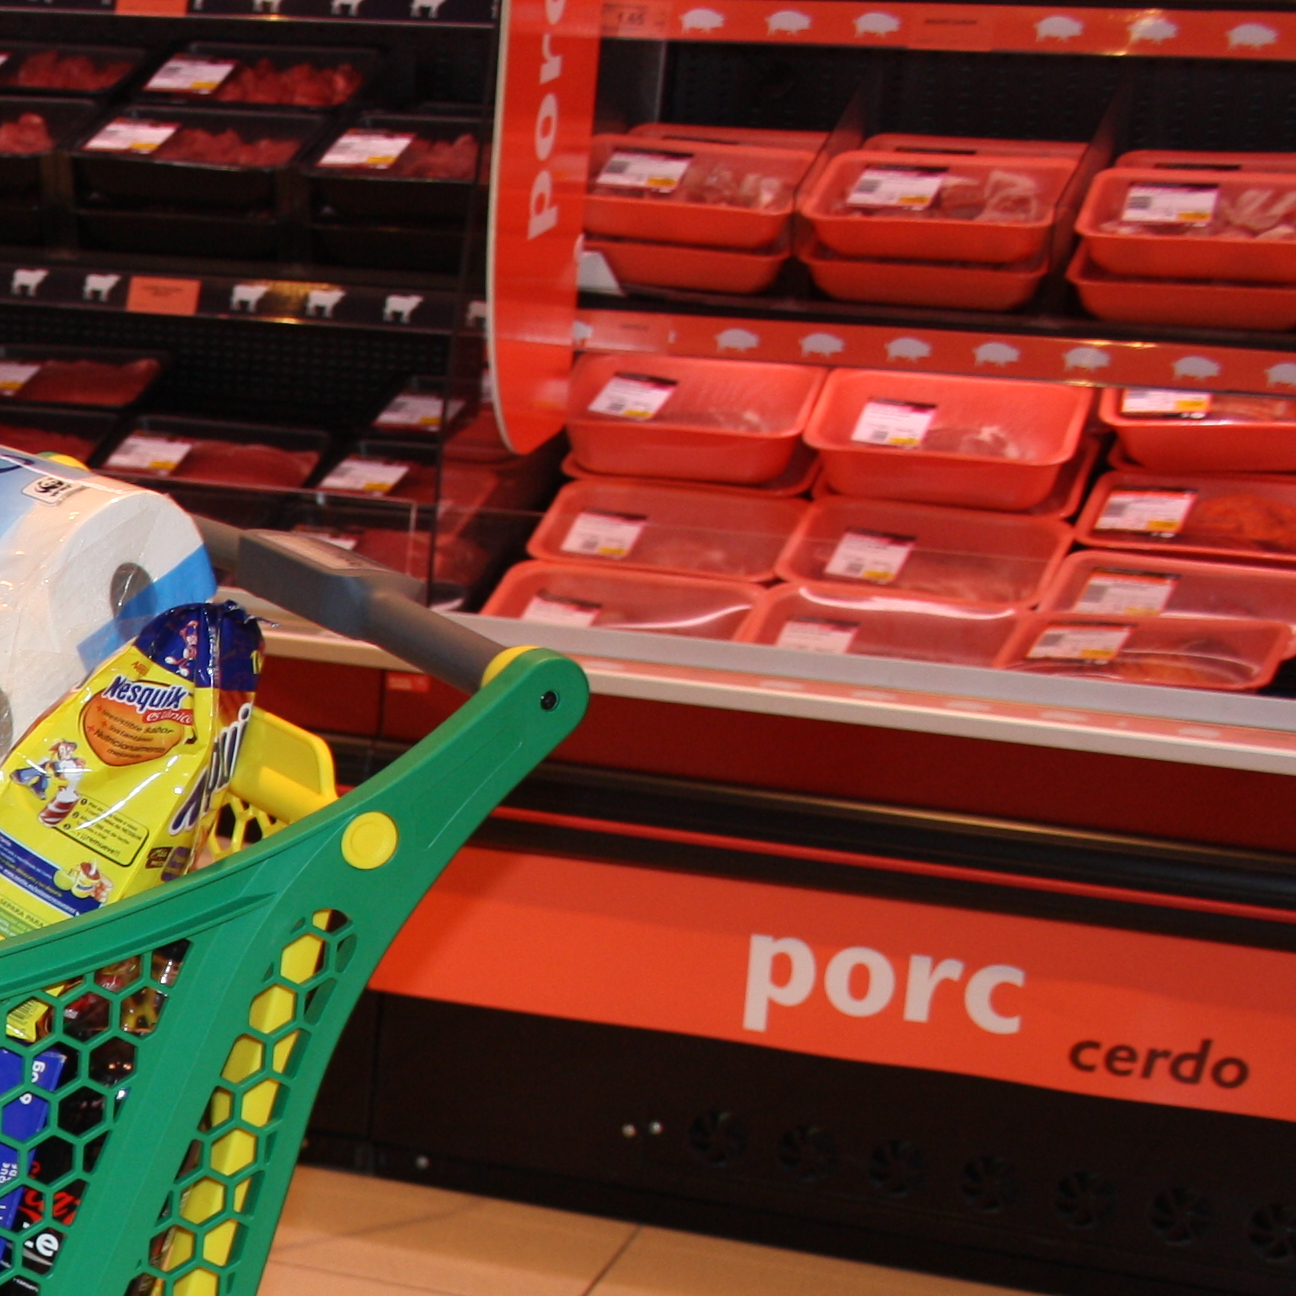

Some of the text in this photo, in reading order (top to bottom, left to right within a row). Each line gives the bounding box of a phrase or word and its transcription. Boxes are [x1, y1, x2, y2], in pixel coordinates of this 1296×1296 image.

[103, 674, 190, 713] Nesquik
[743, 933, 1026, 1035] porc
[1068, 1038, 1250, 1090] cerdo
